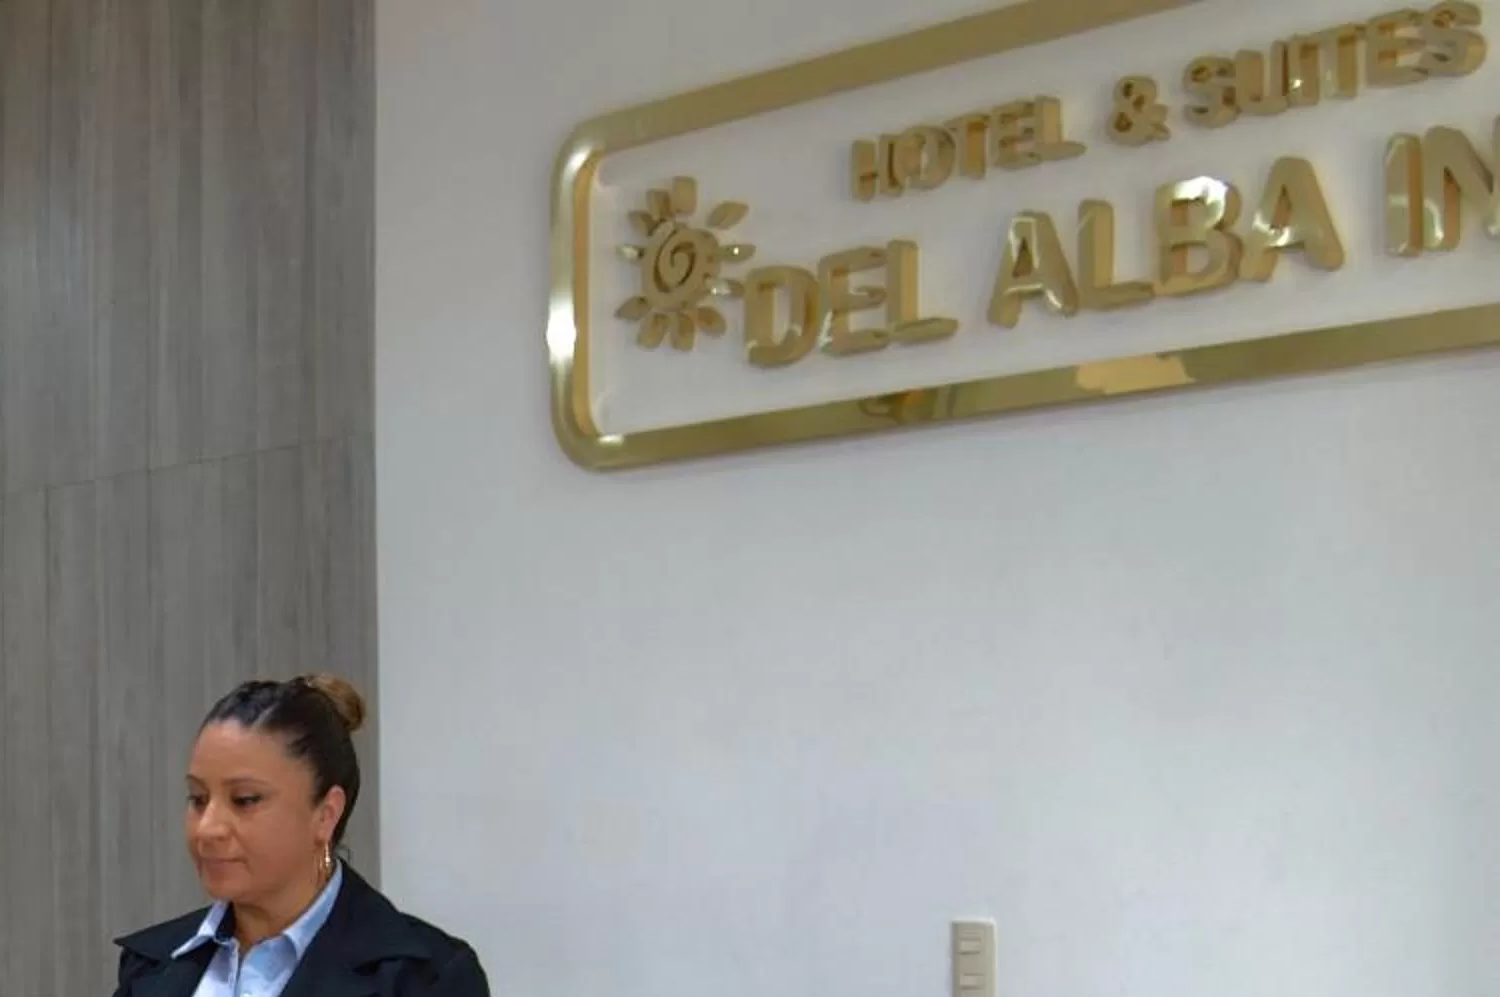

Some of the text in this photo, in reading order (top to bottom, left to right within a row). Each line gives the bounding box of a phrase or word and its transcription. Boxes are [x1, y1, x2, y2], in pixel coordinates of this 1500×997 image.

[850, 0, 1488, 203] HOTEL & SUITES
[743, 239, 960, 367] DEL
[987, 156, 1346, 329] ALBA
